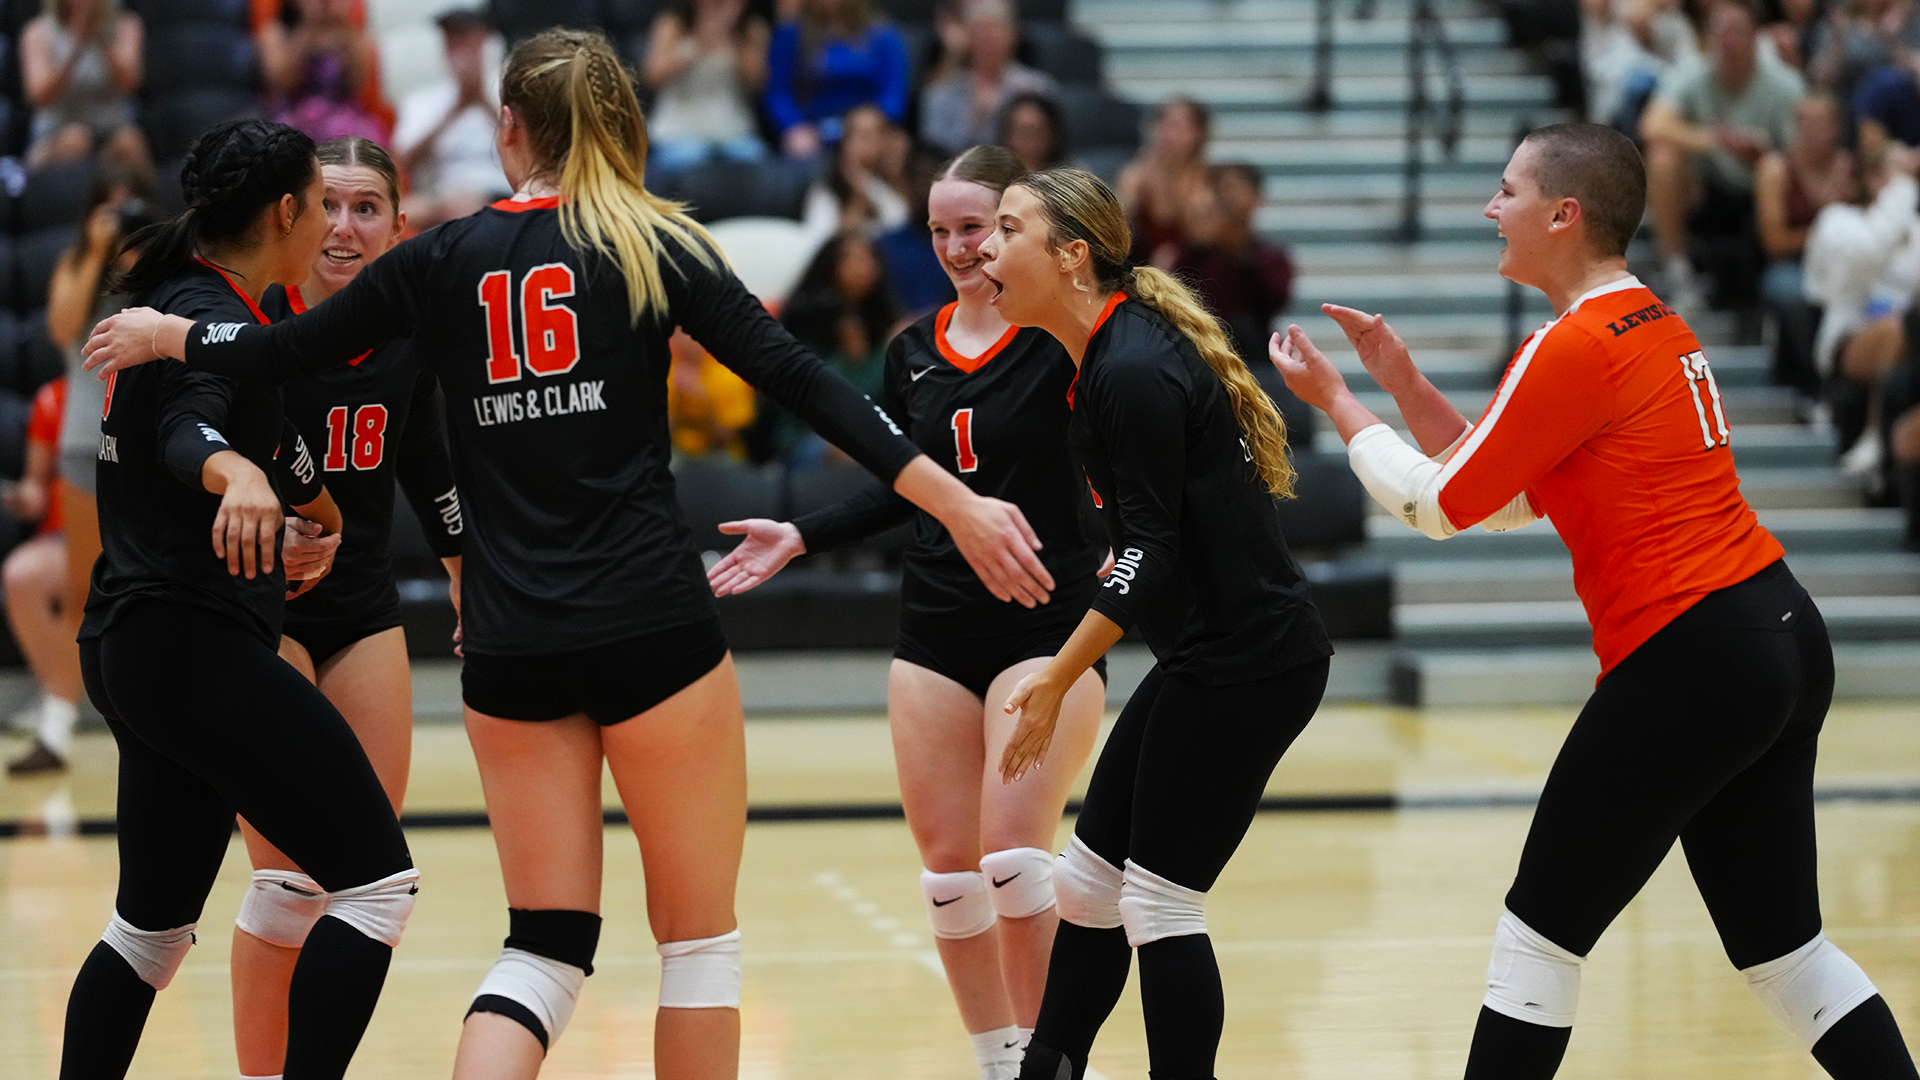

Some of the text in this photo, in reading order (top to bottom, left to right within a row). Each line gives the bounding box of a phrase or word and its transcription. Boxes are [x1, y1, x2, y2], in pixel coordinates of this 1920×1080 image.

[477, 262, 581, 385] 16
[1607, 303, 1662, 337] LEWIS
[473, 380, 607, 427] LEWIS & CLARK
[1678, 350, 1730, 452] 17
[323, 403, 388, 472] 18
[950, 408, 978, 473] 1
